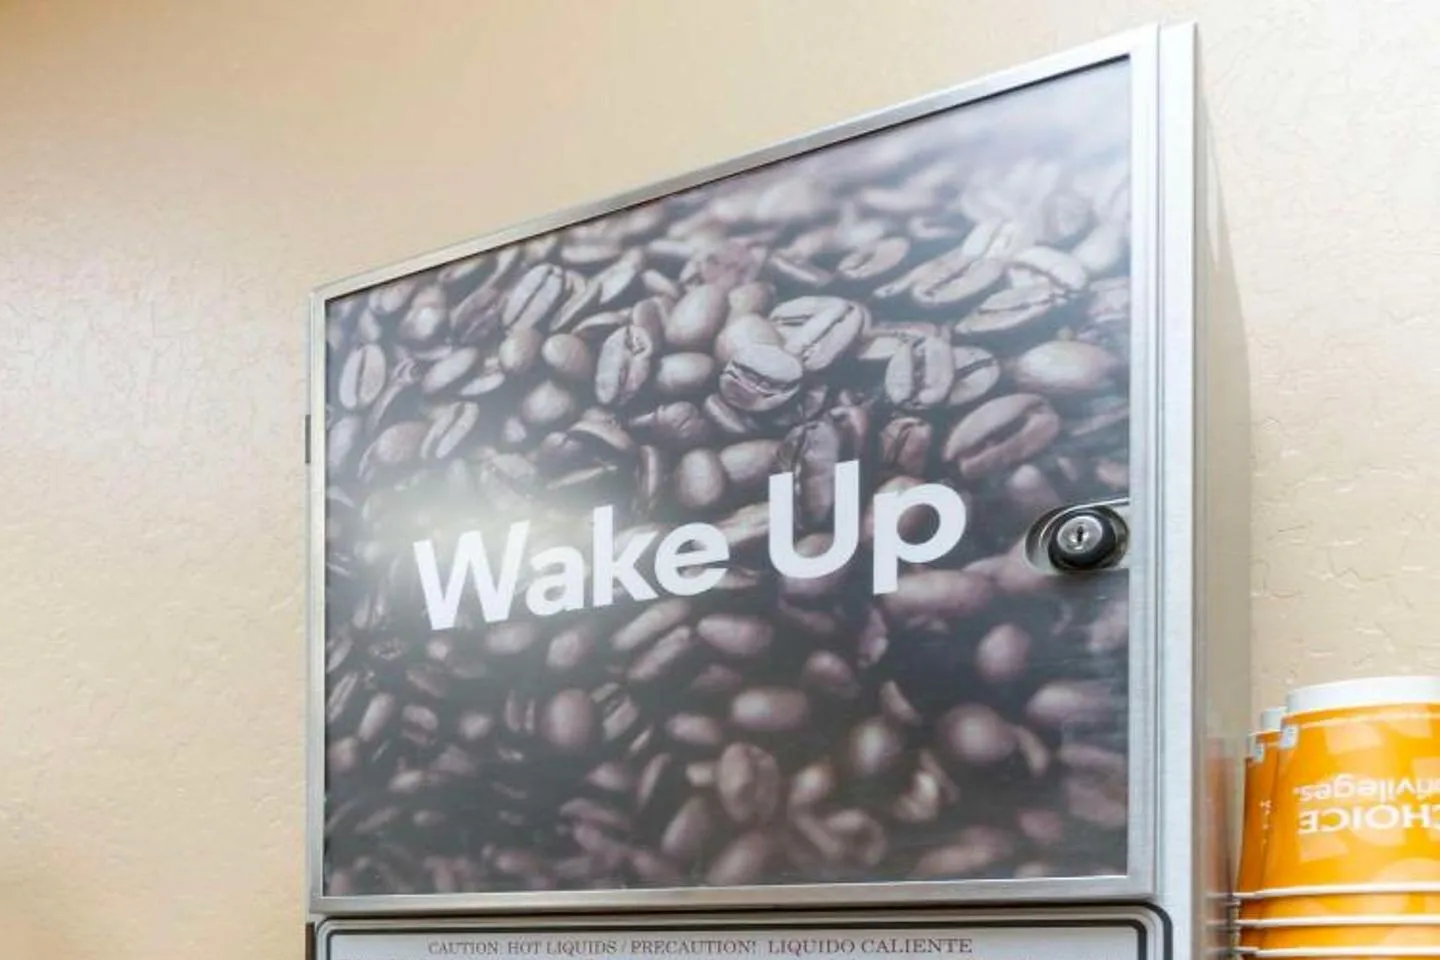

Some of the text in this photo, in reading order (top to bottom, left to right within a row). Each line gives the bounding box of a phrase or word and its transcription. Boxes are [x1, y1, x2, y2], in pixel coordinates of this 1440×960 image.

[413, 459, 967, 630] Wake Up
[507, 940, 542, 955] HOT
[546, 940, 617, 957] LIQUIDS
[768, 938, 856, 957] LIQUIDO
[861, 938, 973, 954] CALIENTE
